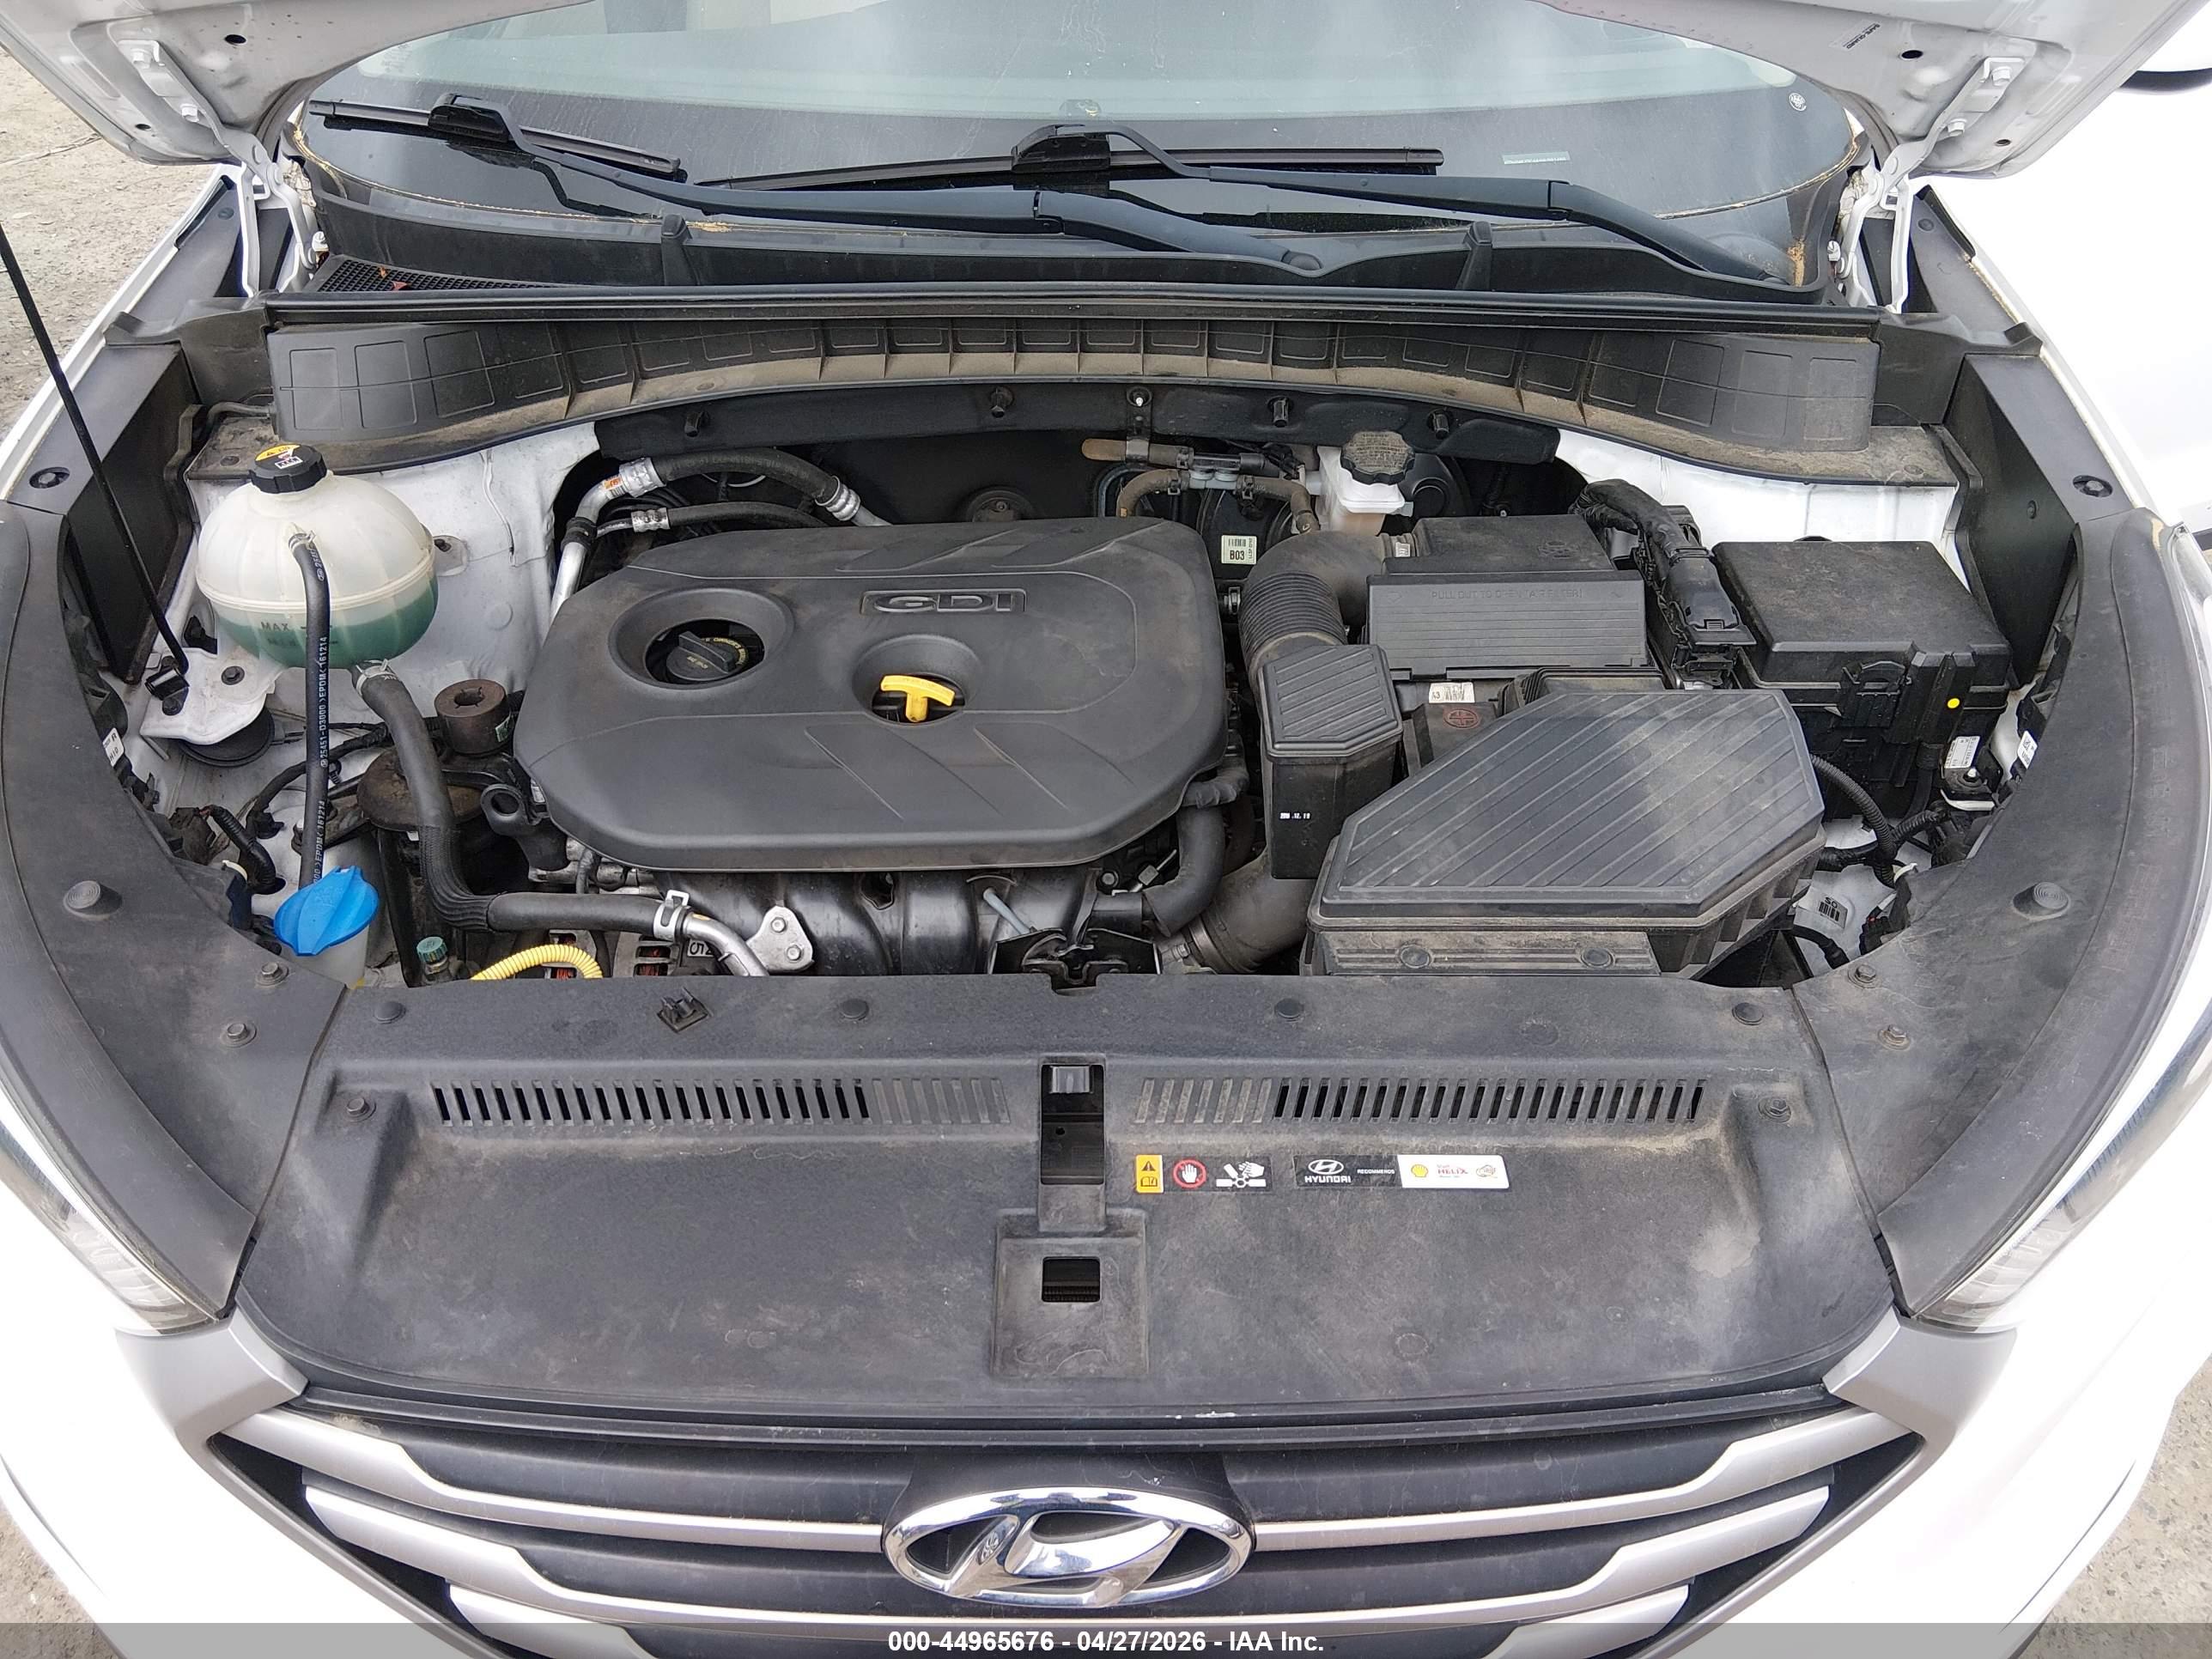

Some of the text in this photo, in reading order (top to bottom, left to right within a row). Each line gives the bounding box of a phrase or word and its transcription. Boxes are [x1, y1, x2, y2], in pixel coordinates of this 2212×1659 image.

[1230, 550, 1245, 560] B03
[1431, 591, 1455, 599] PULL
[873, 593, 1012, 612] GDI
[260, 621, 289, 631] MAX
